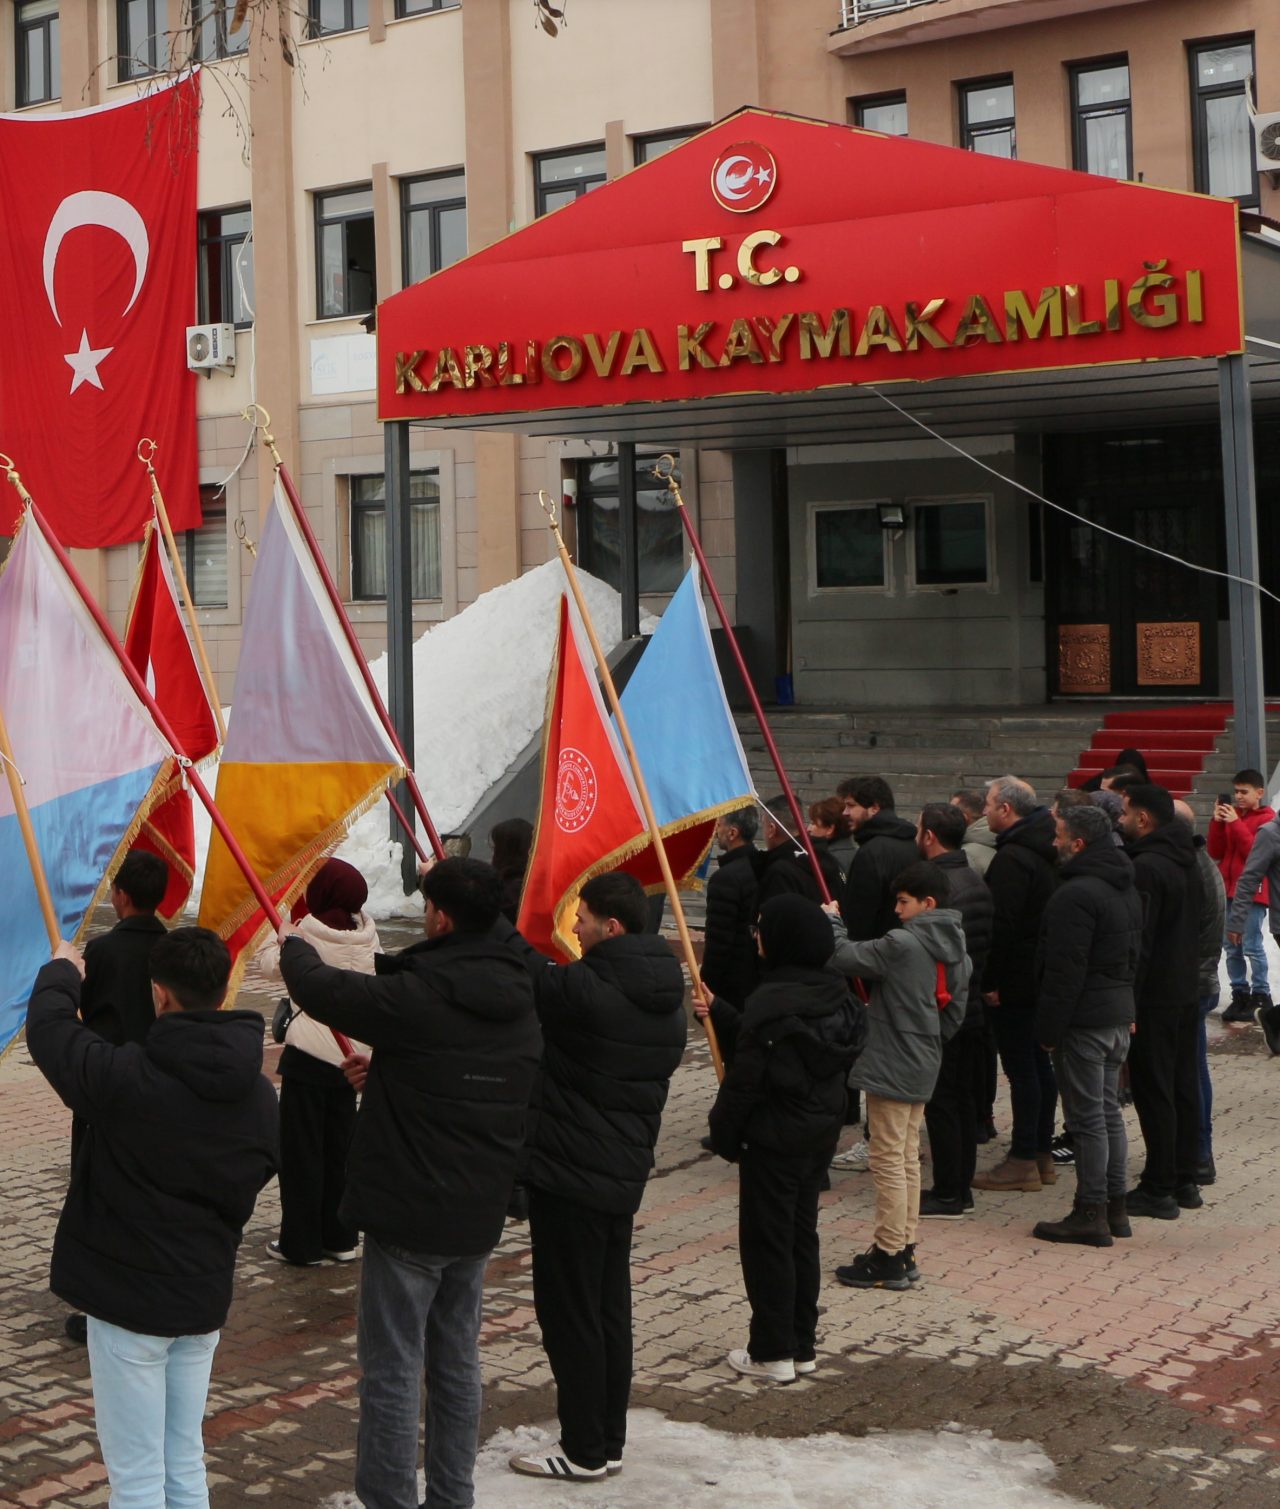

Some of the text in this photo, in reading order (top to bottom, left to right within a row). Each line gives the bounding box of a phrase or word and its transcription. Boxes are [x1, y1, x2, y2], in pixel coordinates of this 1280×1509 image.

[682, 230, 801, 292] T.C.
[395, 259, 1205, 394] KARLIOVA KAYMAKAMLIĞI
